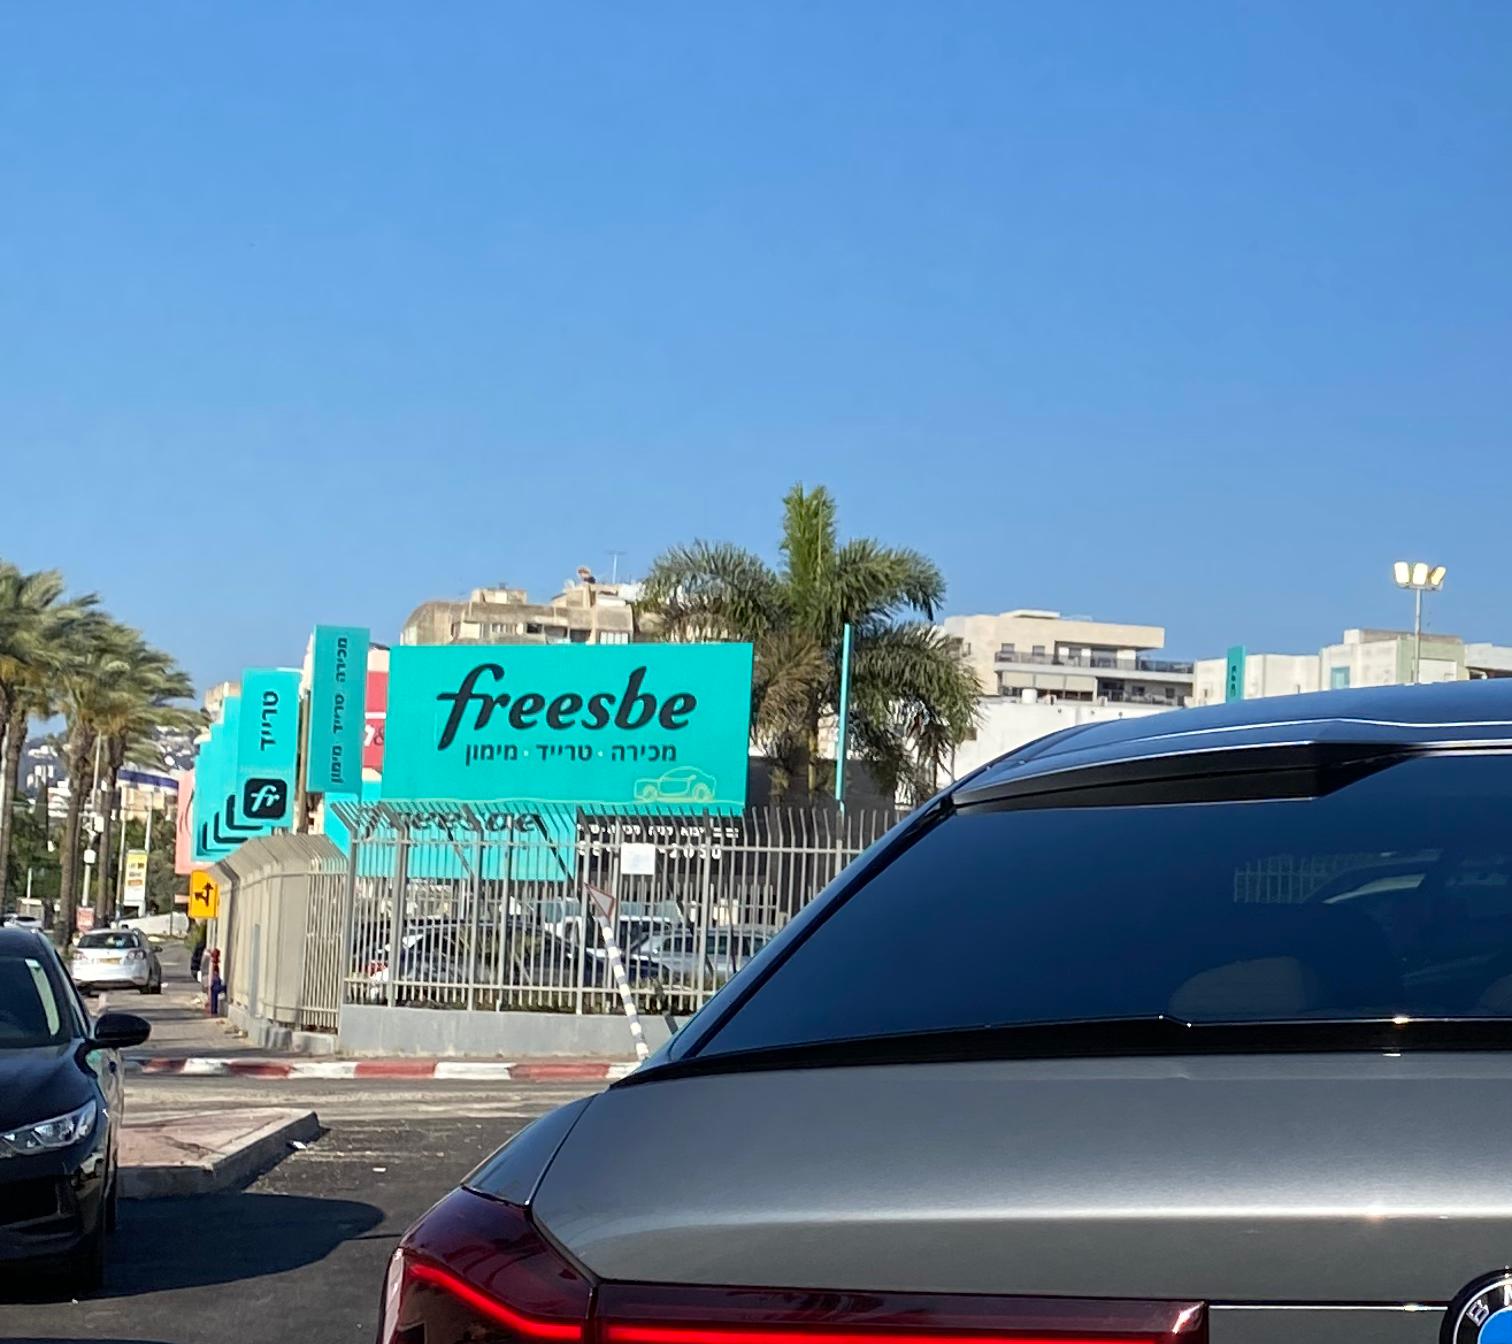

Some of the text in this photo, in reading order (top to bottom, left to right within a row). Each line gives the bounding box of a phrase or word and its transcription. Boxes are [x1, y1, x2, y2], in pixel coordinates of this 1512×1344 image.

[260, 690, 279, 751] טרייד
[436, 663, 697, 751] freesbe
[465, 744, 677, 767] מכירה טרייד מימון
[251, 785, 280, 812] fr
